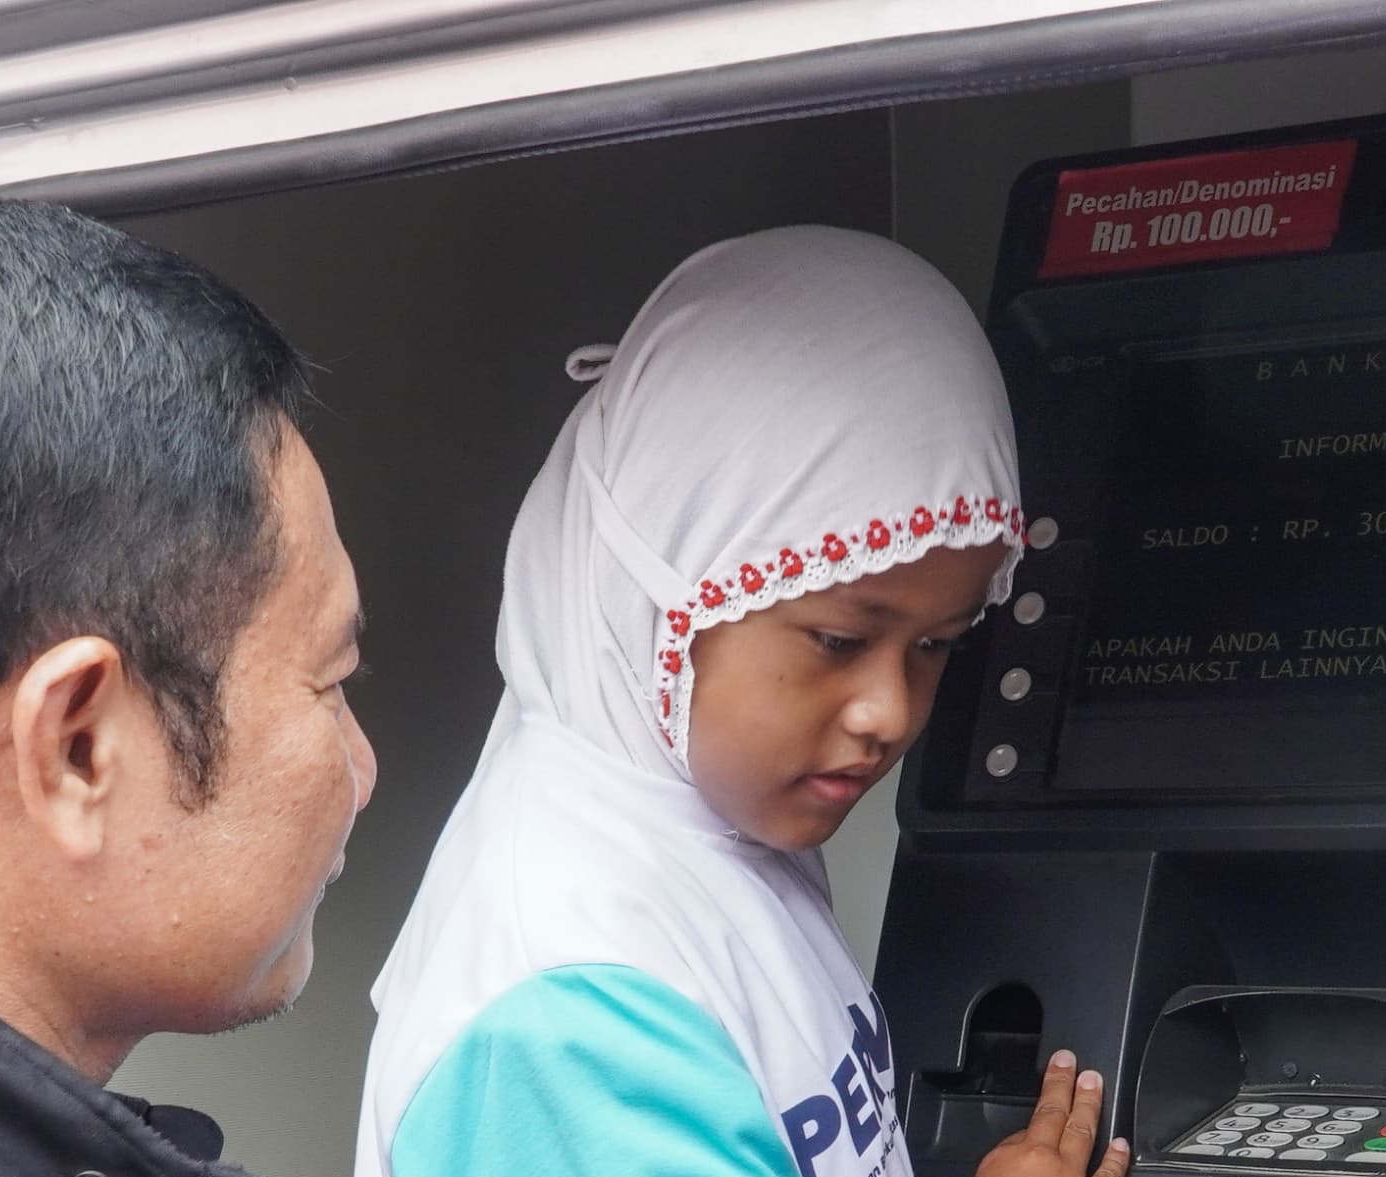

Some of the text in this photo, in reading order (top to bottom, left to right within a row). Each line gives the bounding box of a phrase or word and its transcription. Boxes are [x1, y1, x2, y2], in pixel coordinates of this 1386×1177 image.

[1066, 165, 1336, 216] Pecahan/Denominasi
[1091, 203, 1291, 254] Rp. 100.000,-
[1141, 524, 1229, 550] SALDO
[1282, 518, 1331, 540] RP.
[1087, 636, 1192, 658] APAKAH
[1209, 633, 1281, 653] ANDA
[1085, 661, 1241, 686] TRANSAKSI
